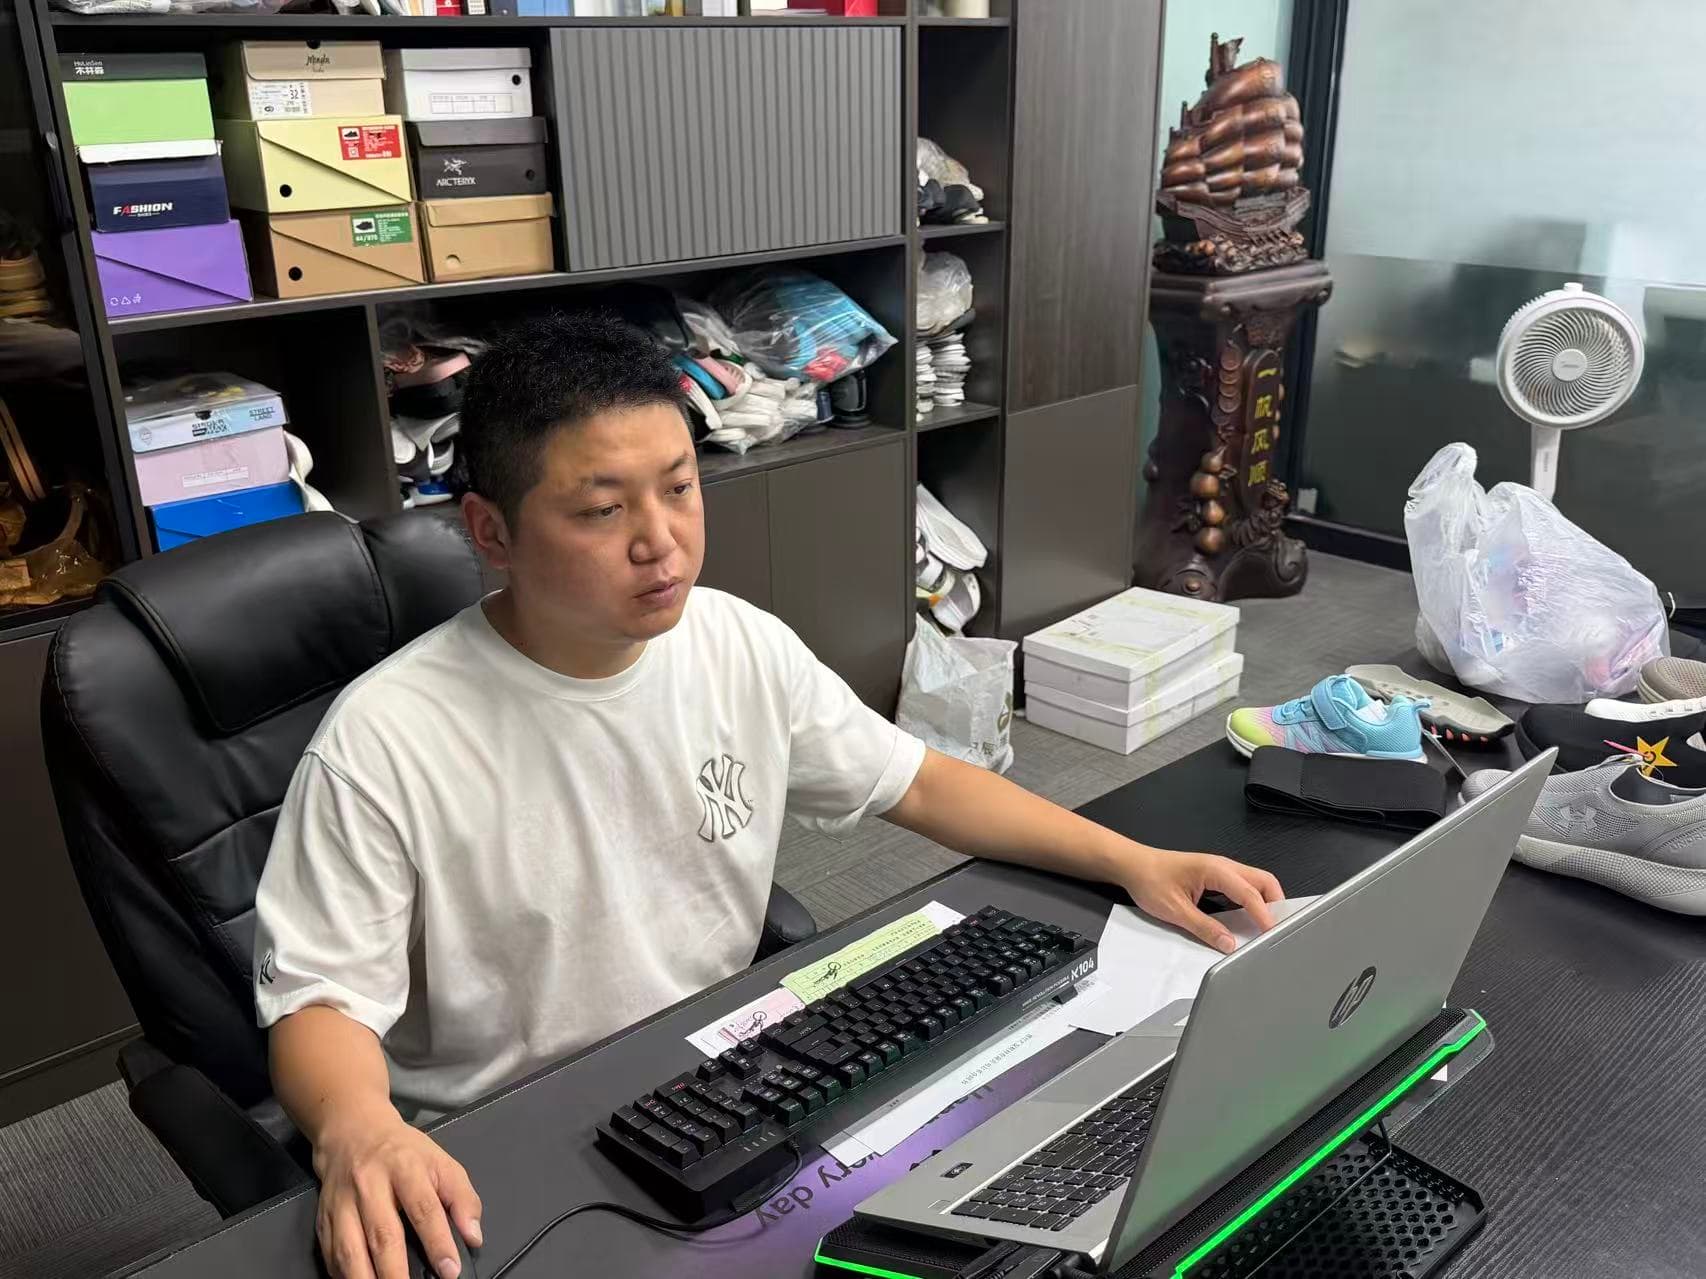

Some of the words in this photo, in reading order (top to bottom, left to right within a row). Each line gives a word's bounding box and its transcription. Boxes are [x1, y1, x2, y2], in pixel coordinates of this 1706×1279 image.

[113, 202, 173, 217] FASHION
[1247, 367, 1277, 488] 一帆风顺
[696, 753, 753, 843] NY
[1071, 957, 1094, 981] K104
[1330, 973, 1375, 1027] hp
[753, 1183, 815, 1230] day
